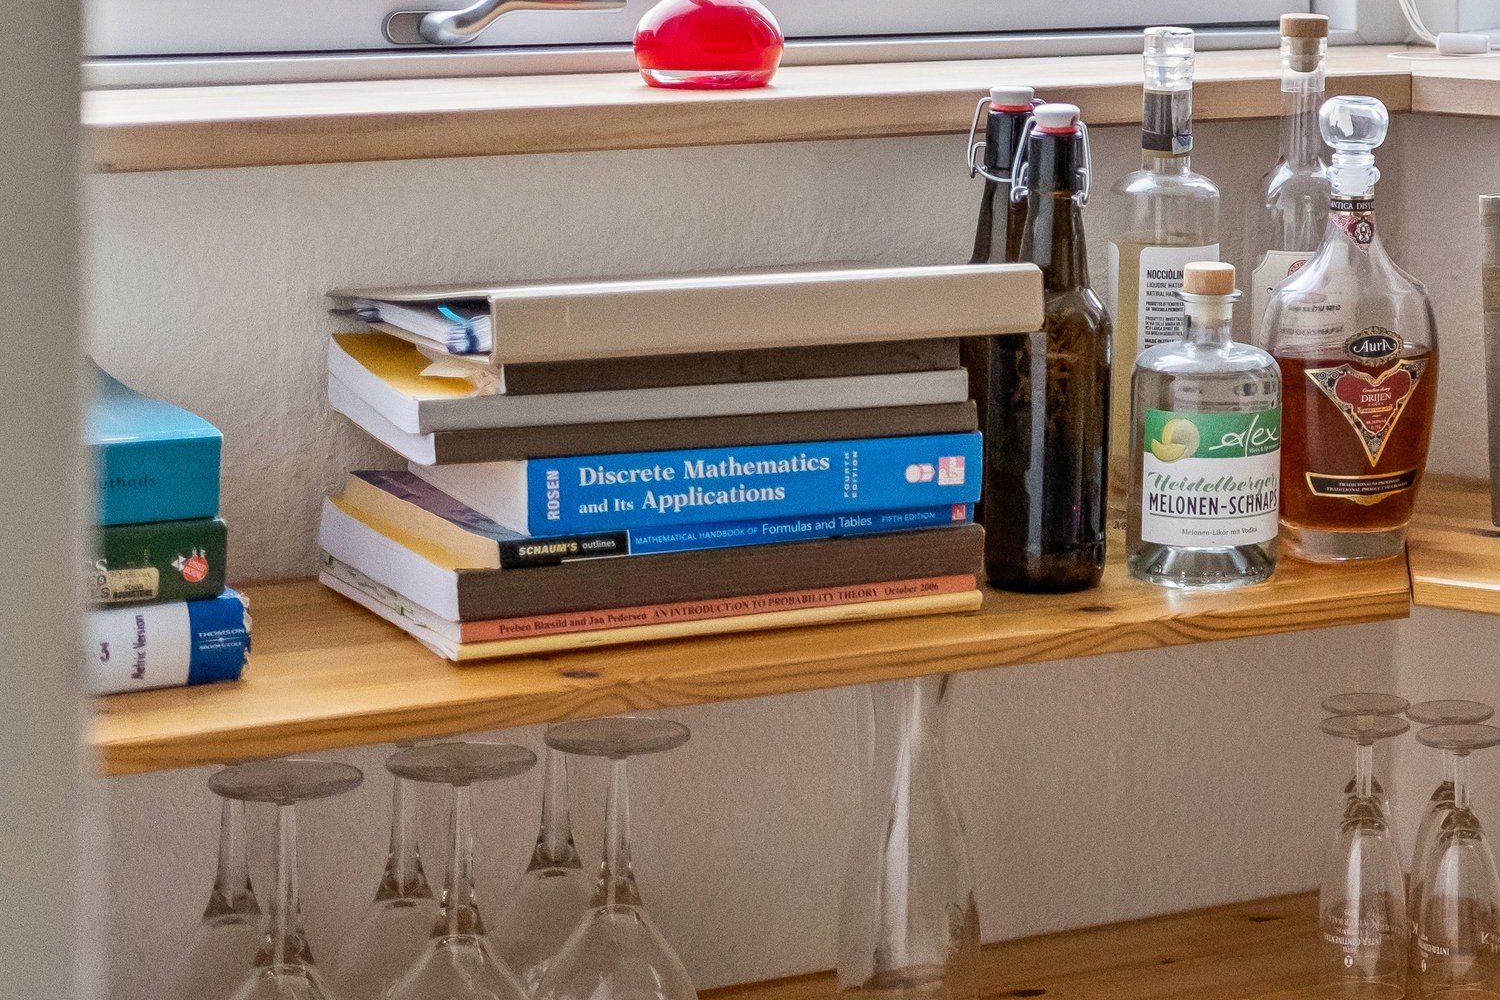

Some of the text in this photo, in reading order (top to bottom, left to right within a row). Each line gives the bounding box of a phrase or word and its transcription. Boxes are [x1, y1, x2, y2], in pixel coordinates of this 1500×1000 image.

[1361, 392, 1392, 403] DRIJEN
[579, 453, 830, 486] Discrete Mathematics
[1147, 471, 1278, 494] Heidelberger
[547, 470, 560, 520] ROSEN
[579, 484, 786, 514] and Its Applications
[1149, 488, 1277, 515] MELONEN-SCHNAPS
[635, 512, 935, 545] MATHEMATICAL HANDBOOK OF Formulas and Tables FIFTH EDITION
[1182, 527, 1258, 536] Melonen-Likör Vodka
[518, 538, 616, 555] SCHAUM'S outlines
[499, 583, 939, 634] Preben Blæsild and Jan Pedersen AN INTRODUCTION TO PROBABILITY THEORY October 2006
[131, 614, 146, 680] Metric Version
[198, 628, 244, 639] THOMSON
